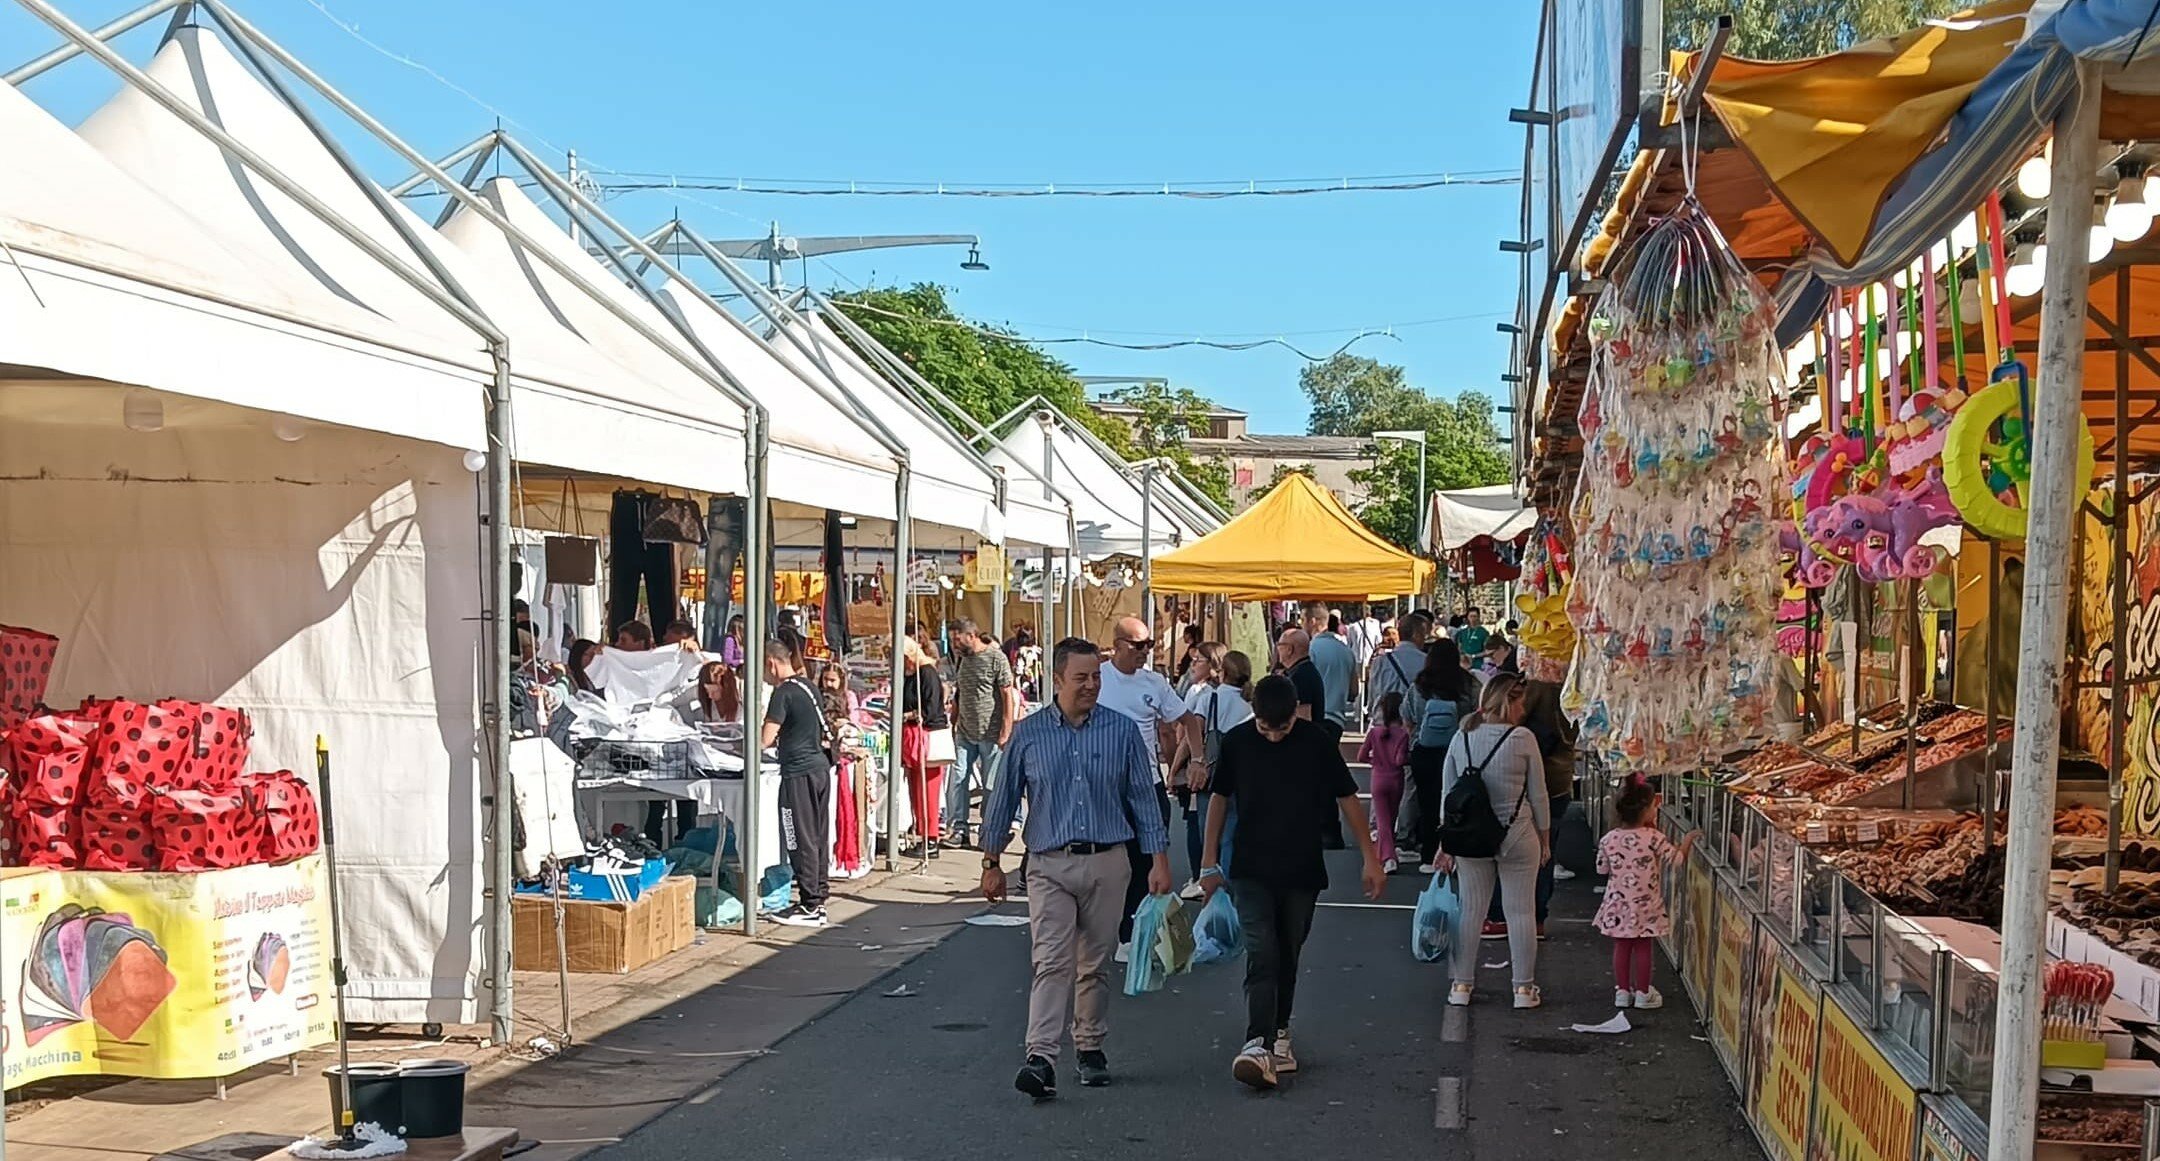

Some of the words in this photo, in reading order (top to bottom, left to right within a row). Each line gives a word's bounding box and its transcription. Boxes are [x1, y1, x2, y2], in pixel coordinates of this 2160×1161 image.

[26, 1049, 82, 1068] Macchina
[1778, 988, 1814, 1077] FRUTTA
[1775, 1060, 1806, 1154] SECCA
